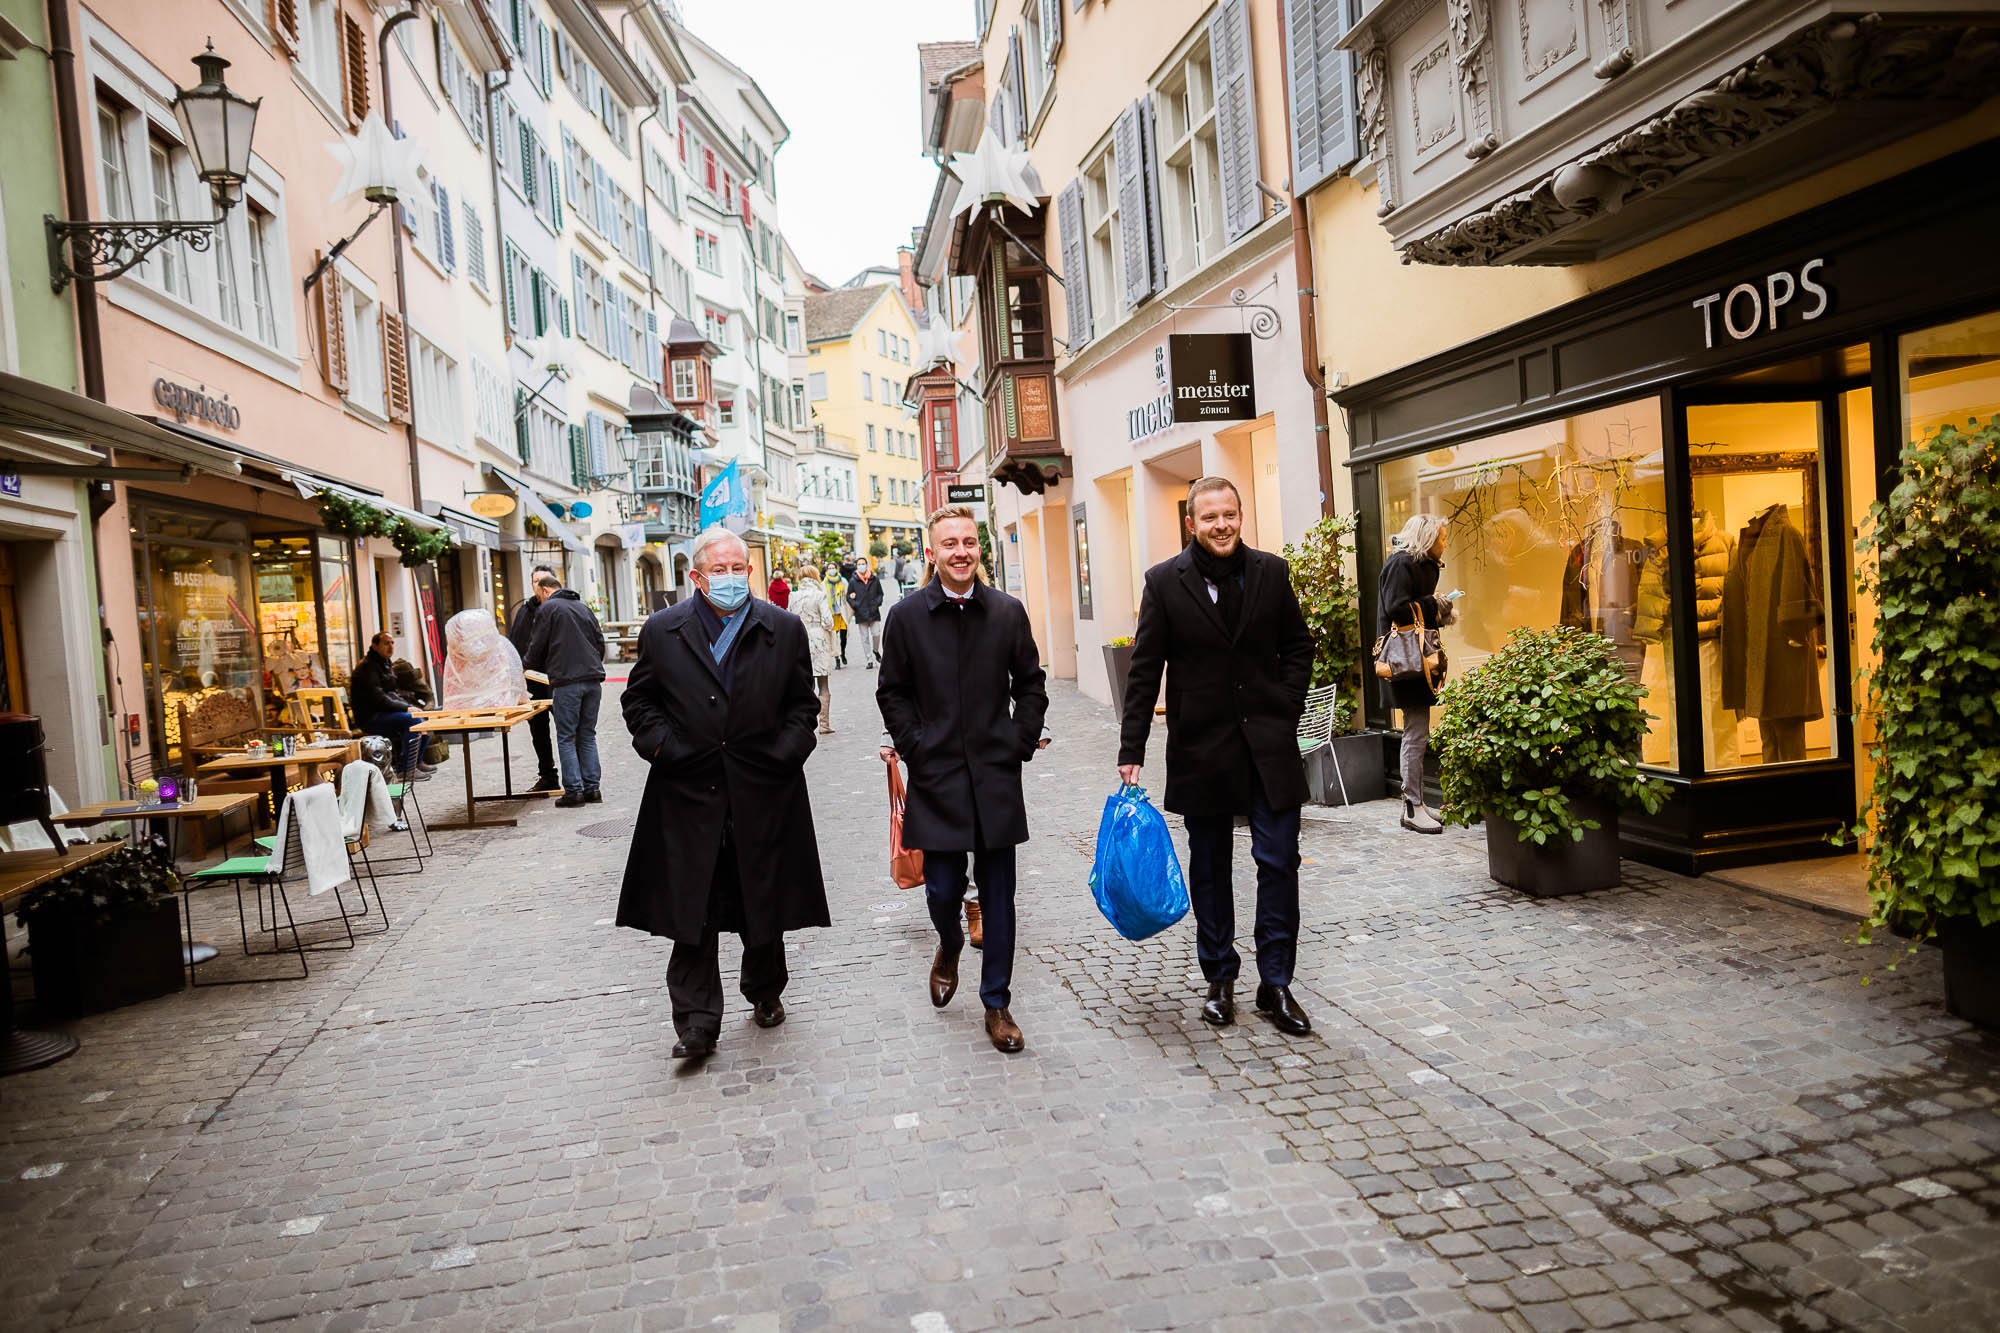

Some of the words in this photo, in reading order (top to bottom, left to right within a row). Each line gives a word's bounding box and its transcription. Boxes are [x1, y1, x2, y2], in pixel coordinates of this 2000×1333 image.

[1692, 258, 1828, 349] TOPS
[154, 377, 241, 430] capriccio
[1177, 382, 1250, 399] meister
[1200, 406, 1230, 415] ZÜRICH
